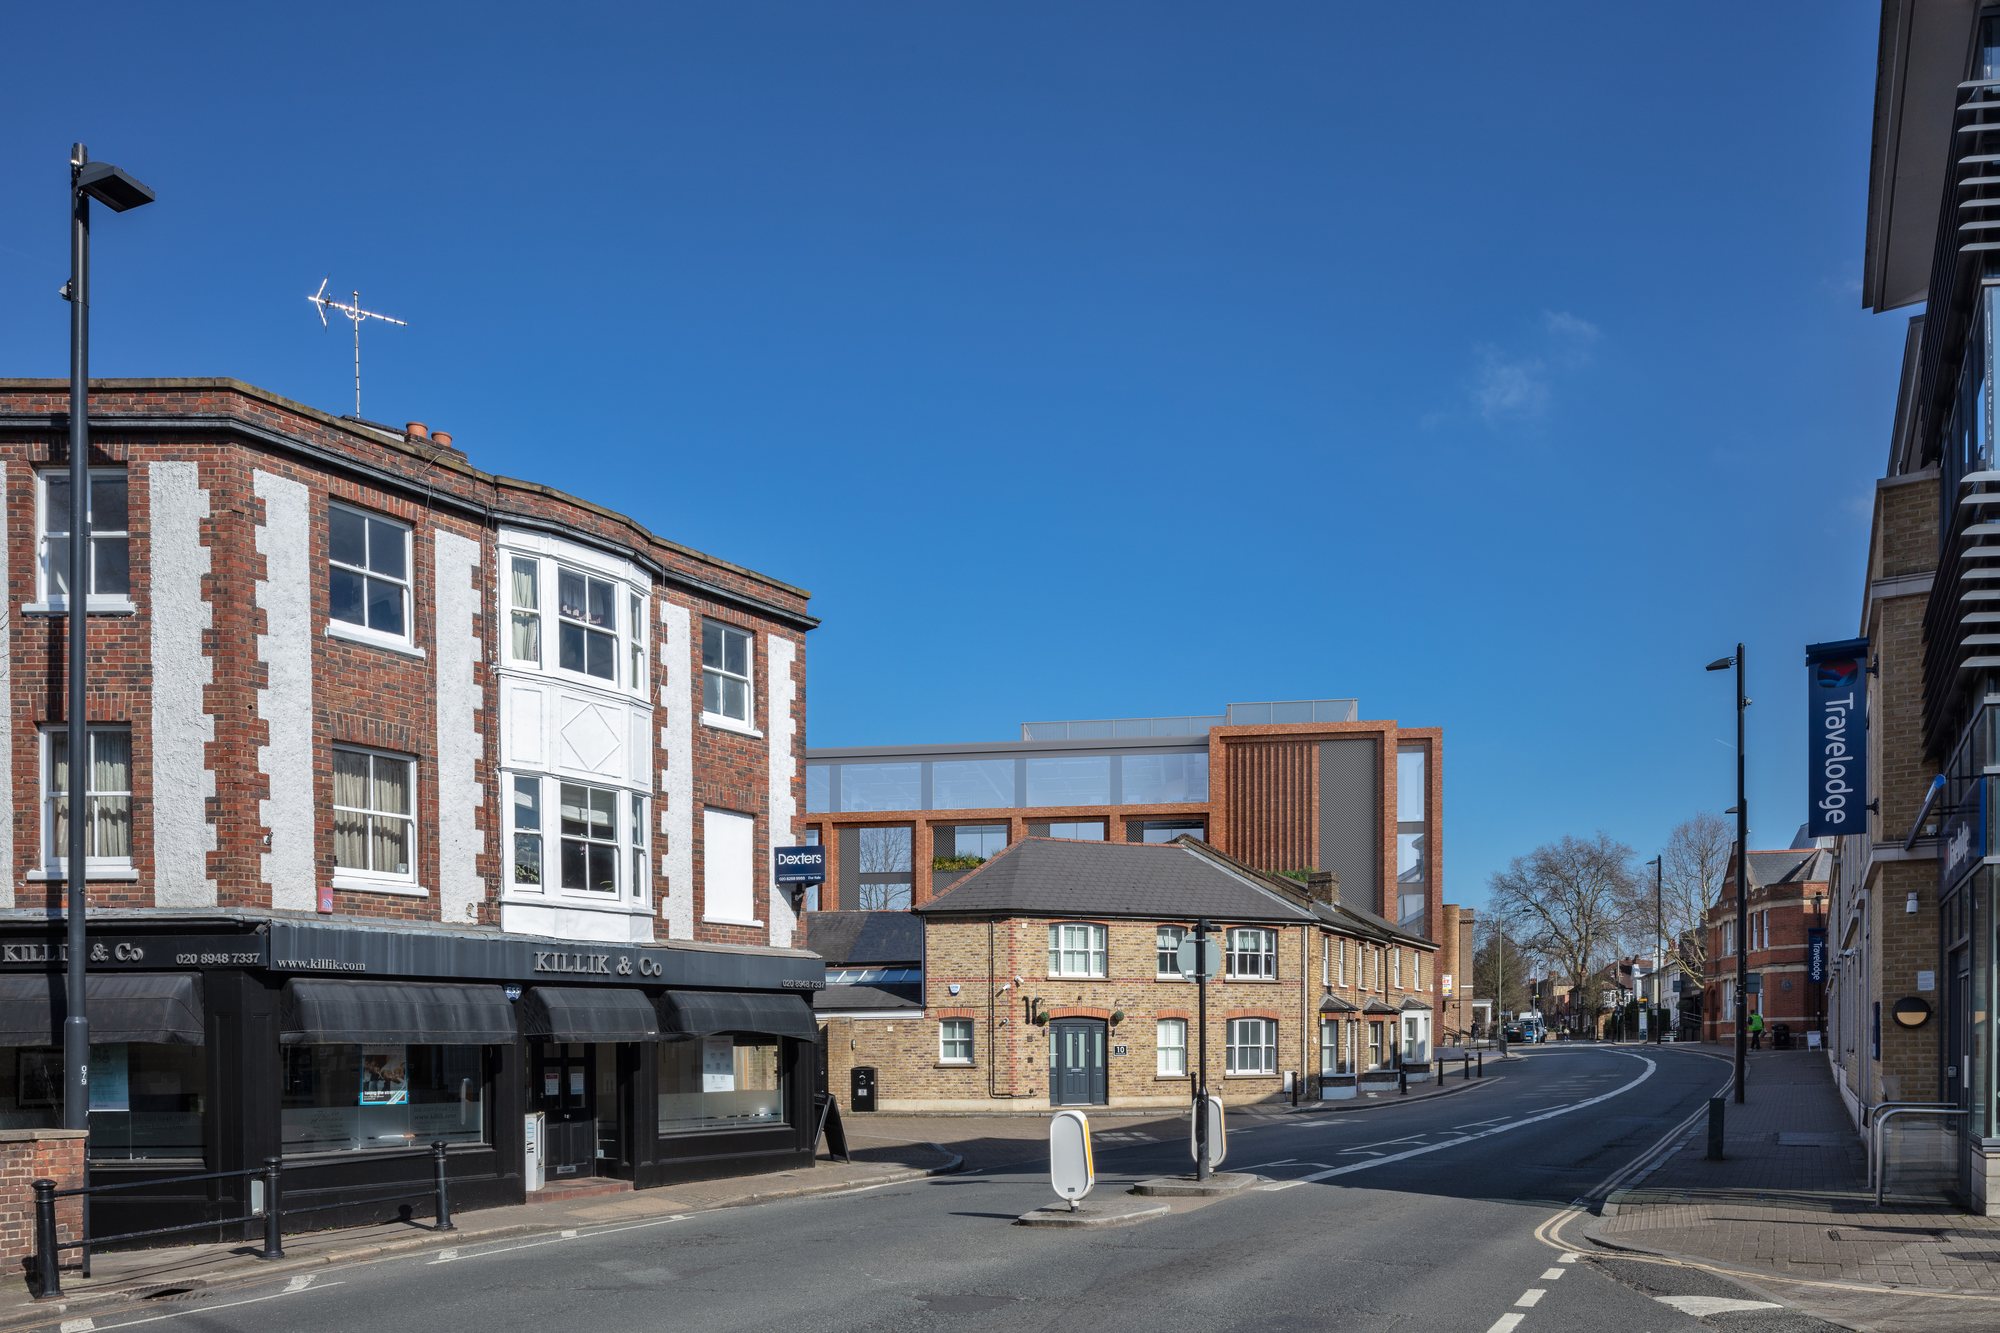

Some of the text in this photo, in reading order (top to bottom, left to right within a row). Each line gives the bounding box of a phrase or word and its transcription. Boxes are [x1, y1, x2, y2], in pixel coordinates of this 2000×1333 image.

[1818, 692, 1854, 824] Travelodge
[778, 853, 822, 865] Dexters
[2, 943, 144, 962] KILLI & Co
[176, 952, 261, 965] 020 8948 7337
[277, 958, 366, 971] www.killik.com
[534, 951, 663, 977] KILLIK & Co
[1811, 941, 1823, 981] Travelodge
[783, 979, 825, 988] 020 8948 7337
